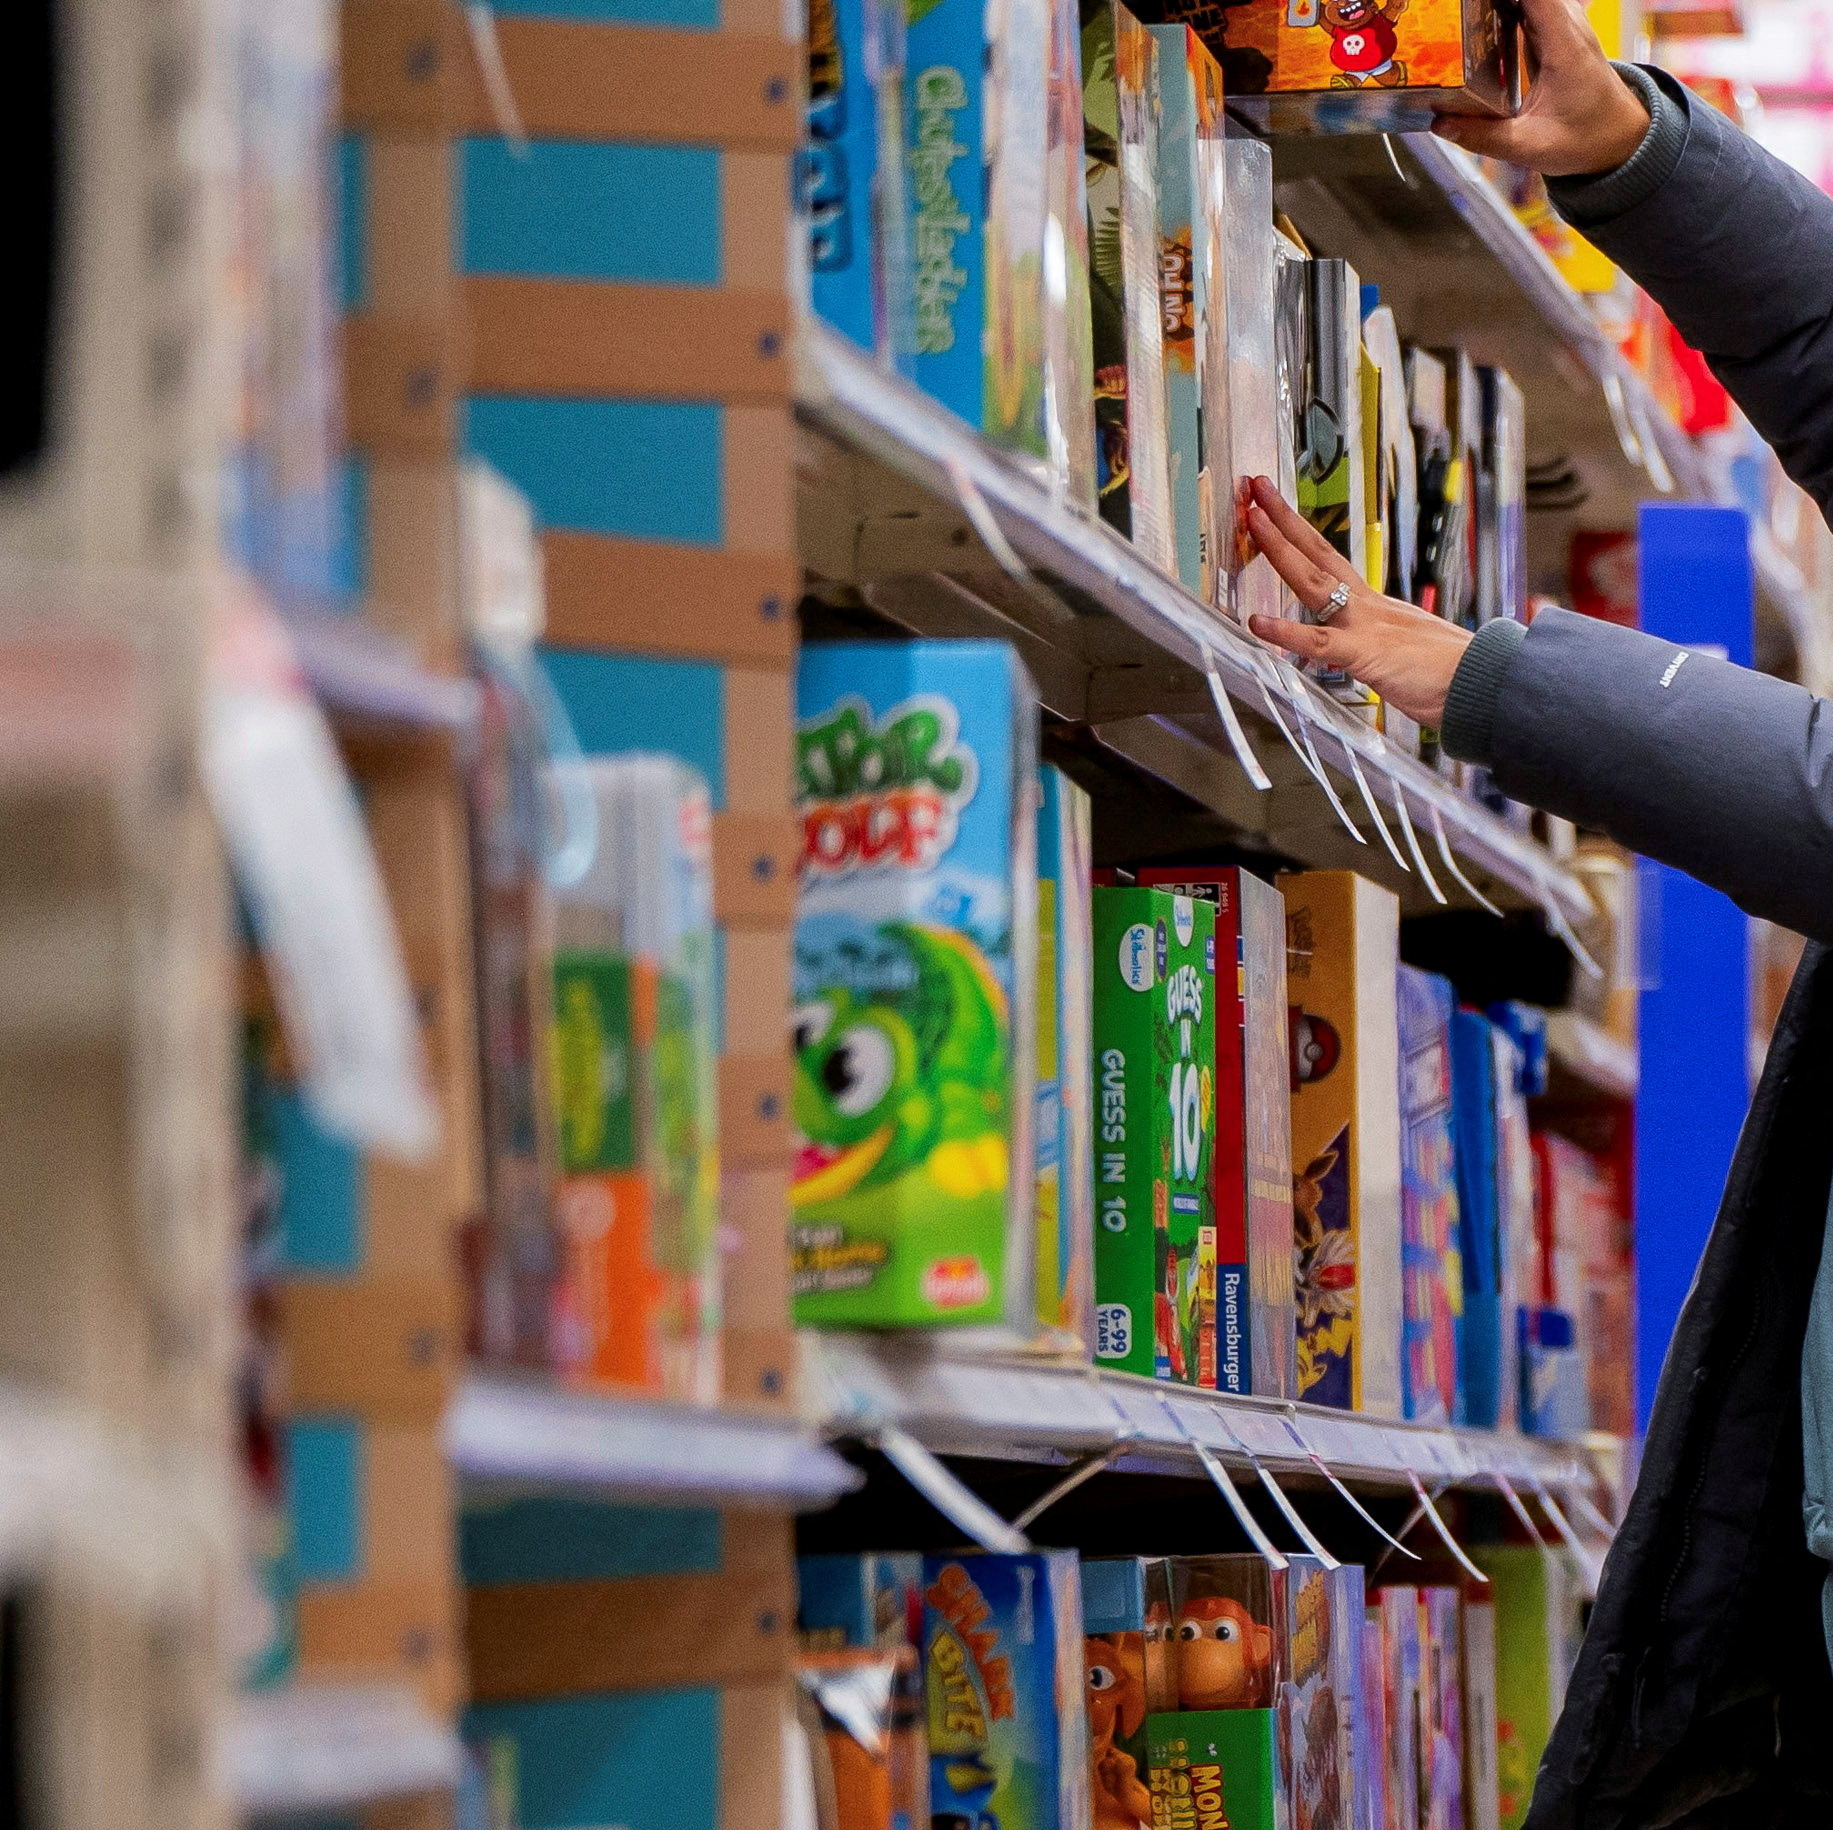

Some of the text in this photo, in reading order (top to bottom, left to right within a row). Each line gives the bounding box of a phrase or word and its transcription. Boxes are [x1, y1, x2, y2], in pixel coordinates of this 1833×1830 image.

[1166, 965, 1204, 1026] GUESS
[1101, 1049, 1127, 1233] GUESS IN 10
[1168, 1062, 1201, 1181] 10
[1098, 1309, 1108, 1352] YEARS
[1110, 1308, 1127, 1353] 6-99
[1223, 1272, 1241, 1392] Ravensburger
[928, 1631, 986, 1740] BITE
